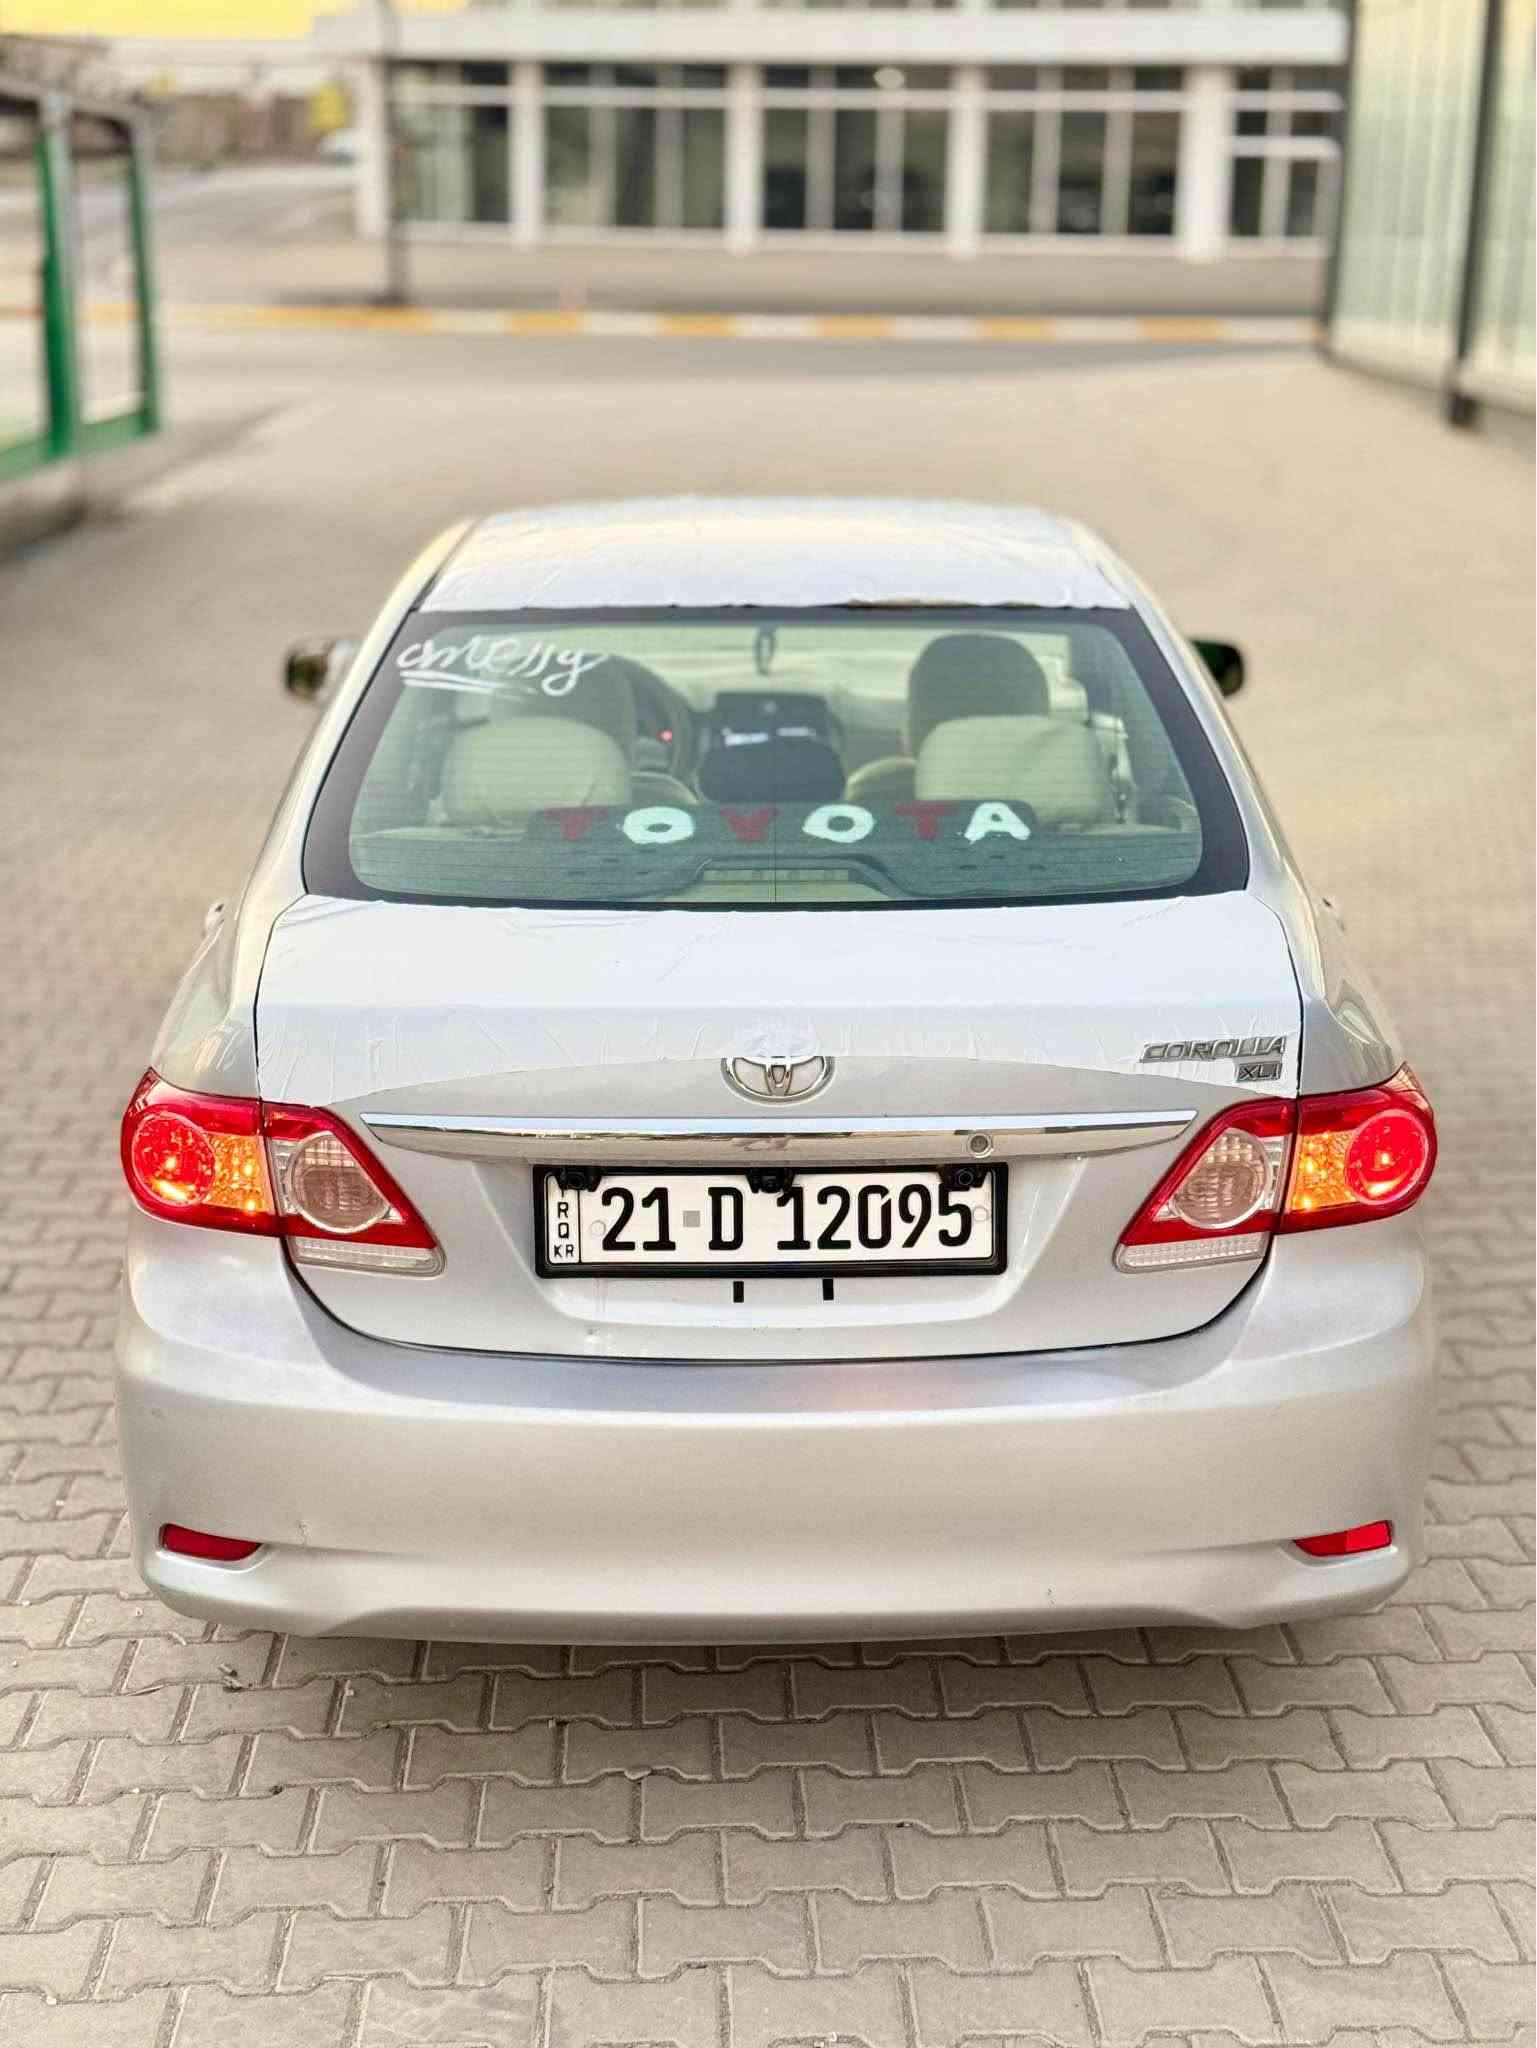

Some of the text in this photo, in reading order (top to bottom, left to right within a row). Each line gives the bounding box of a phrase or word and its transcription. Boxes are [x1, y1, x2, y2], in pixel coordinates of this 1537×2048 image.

[543, 801, 1031, 844] TOYOTA
[1140, 1036, 1285, 1063] COROLLA
[601, 1183, 972, 1251] 21 D 12095
[553, 1244, 575, 1258] KR
